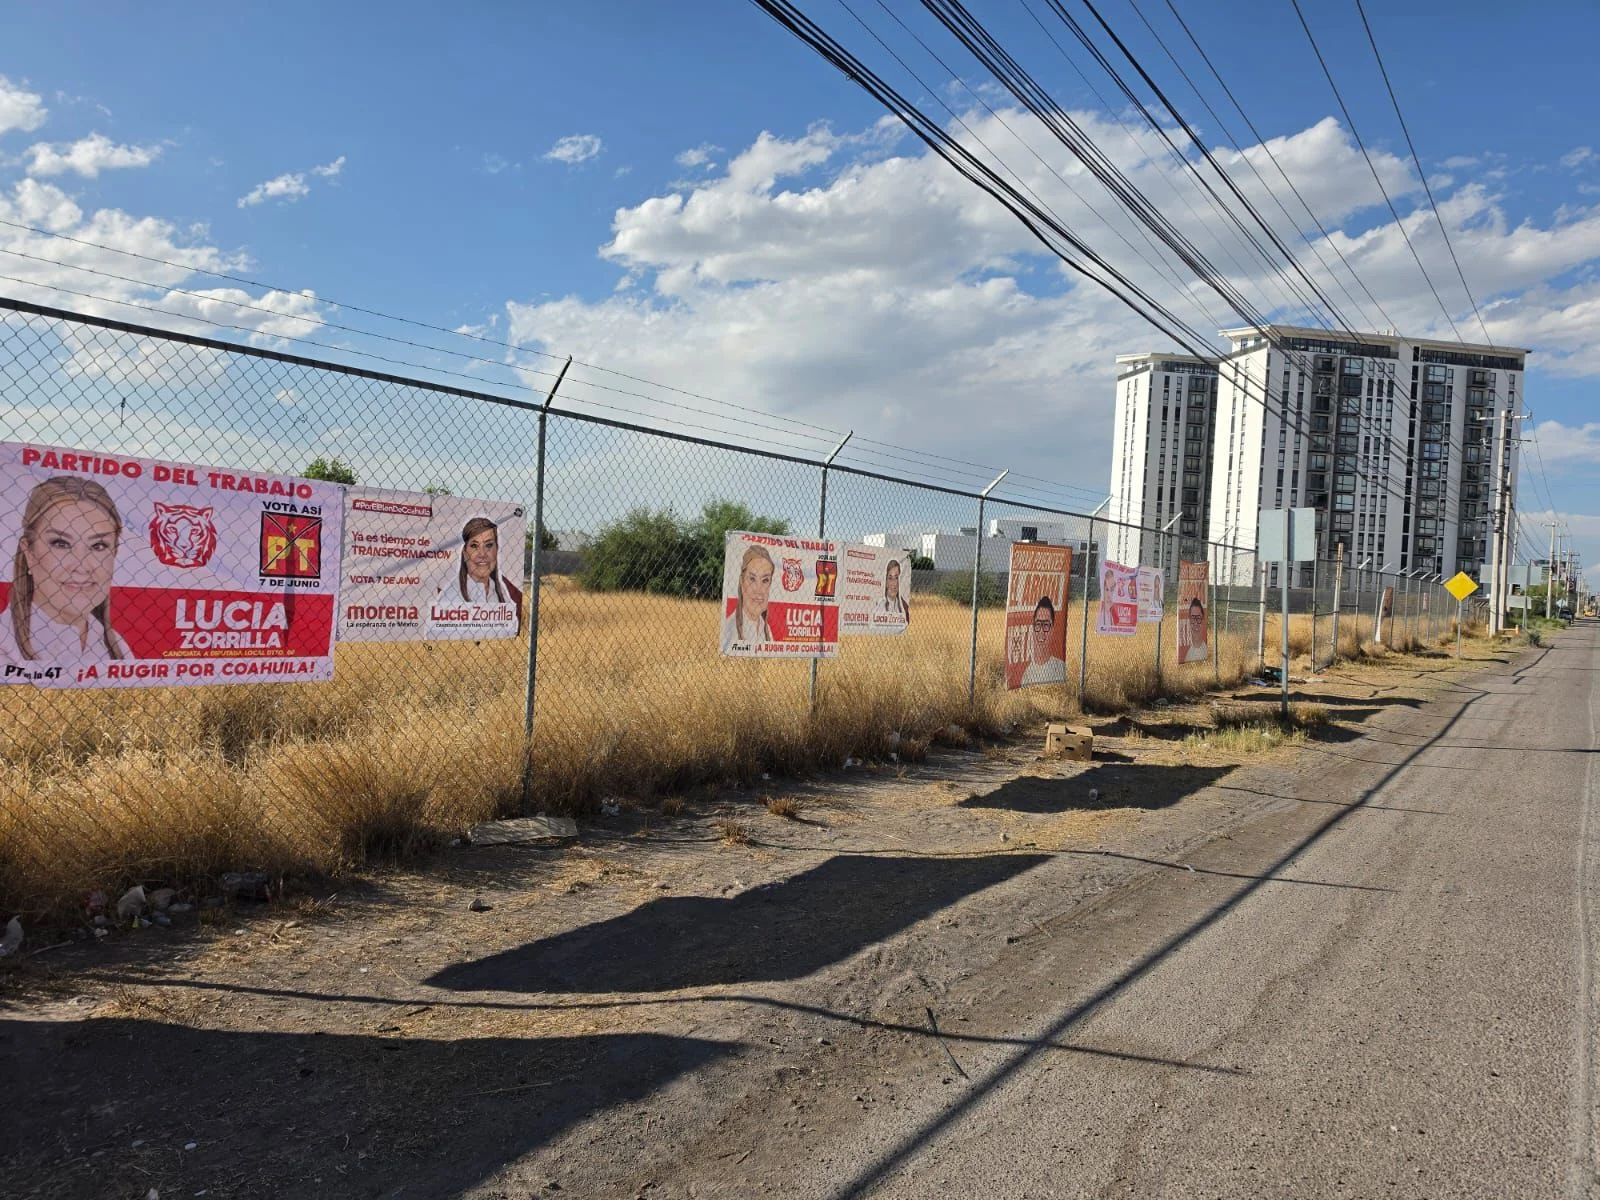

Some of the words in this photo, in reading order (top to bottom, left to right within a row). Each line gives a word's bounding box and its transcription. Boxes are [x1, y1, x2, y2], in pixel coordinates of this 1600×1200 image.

[22, 448, 142, 478] PARTIDO
[153, 465, 198, 486] DEL
[208, 472, 312, 499] TRABAJO
[263, 501, 298, 513] VOTA
[352, 531, 364, 542] Ya
[366, 534, 378, 543] es
[380, 533, 415, 547] tiempo
[417, 537, 430, 546] de
[742, 534, 783, 547] PARTIDO
[784, 539, 799, 549] DEL
[801, 541, 835, 552] TRABAJO
[267, 535, 315, 571] PT
[259, 579, 266, 587] 7
[270, 579, 284, 587] DE
[287, 580, 320, 588] JUNIO
[350, 576, 375, 584] VOTA
[396, 576, 420, 585] JUNIO
[175, 599, 289, 630] LUCIA
[347, 605, 418, 620] morena
[431, 605, 469, 621] Lucía
[472, 605, 513, 621] Zorrilla
[786, 608, 822, 626] LUCIA
[788, 626, 820, 637] ZORRILLA
[180, 631, 281, 649] ZORRILLA
[765, 643, 784, 652] RUGIR
[786, 644, 800, 653] POR
[4, 665, 25, 677] PT
[34, 671, 42, 679] la
[45, 667, 62, 679] 4T
[78, 663, 98, 682] ¡A
[107, 664, 169, 679] RUGIR
[176, 663, 214, 677] POR
[222, 661, 315, 676] COAHUILA!
